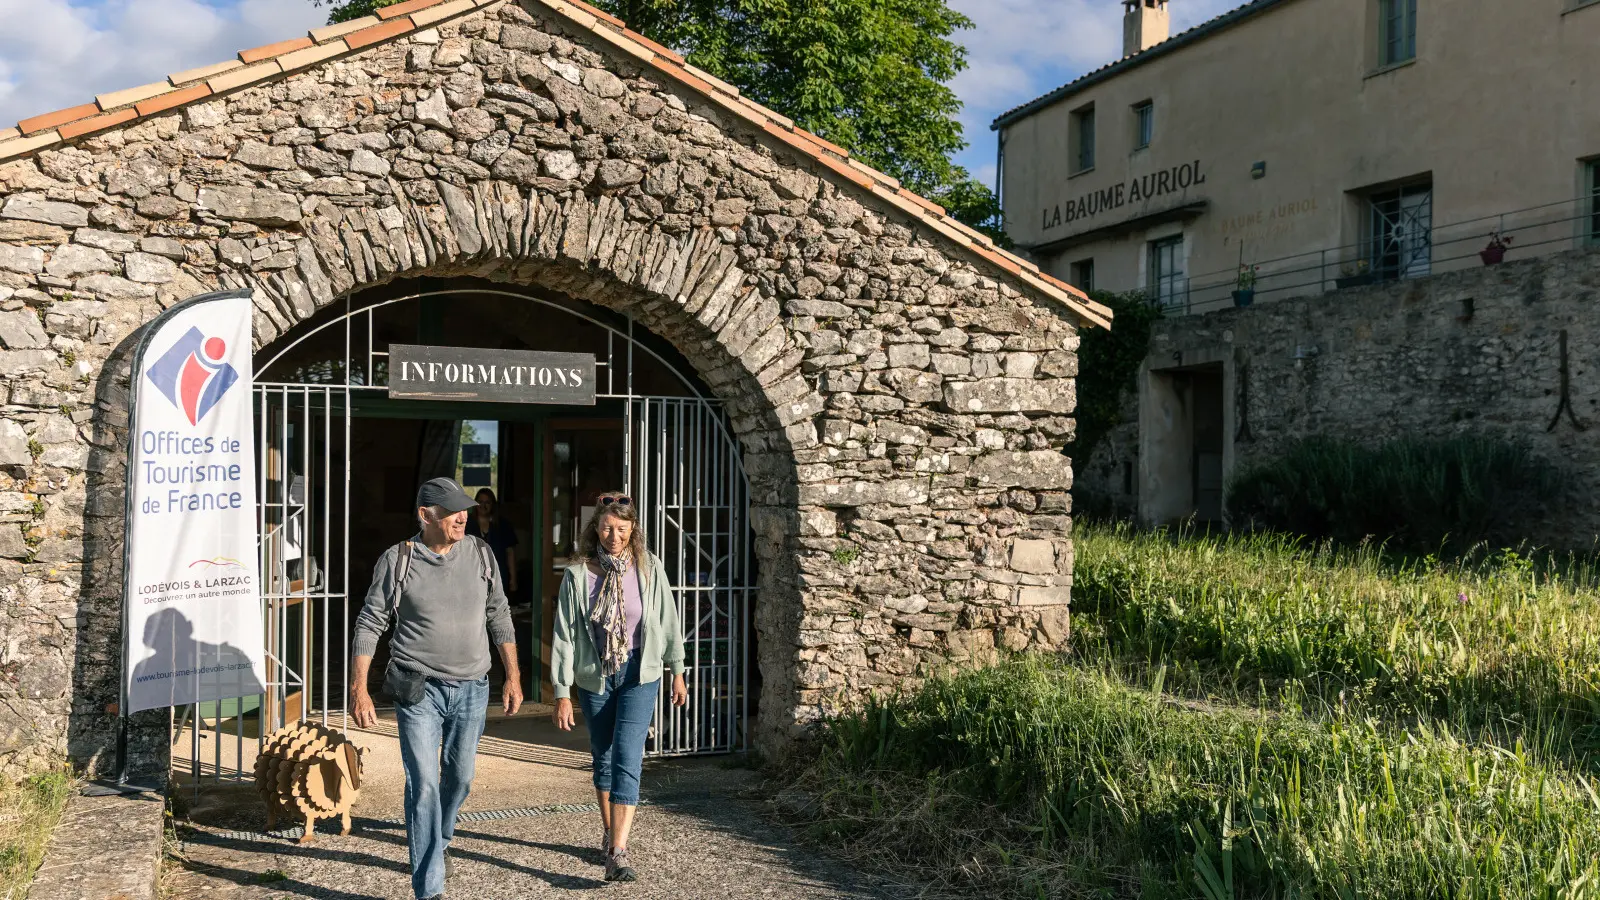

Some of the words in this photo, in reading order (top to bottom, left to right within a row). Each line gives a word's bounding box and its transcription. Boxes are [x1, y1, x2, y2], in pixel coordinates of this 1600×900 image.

[1042, 205, 1062, 231] LA
[1065, 182, 1125, 223] BAUME
[1128, 159, 1206, 204] AURIOL
[1221, 210, 1263, 233] BAUME
[1268, 197, 1318, 221] AURIOL
[401, 361, 583, 388] INFORMATIONS
[142, 430, 214, 455] Offices
[221, 436, 240, 453] de
[142, 460, 241, 484] Tourisme
[142, 497, 160, 515] de
[168, 489, 242, 513] France
[138, 581, 190, 595] LODÉVOIS
[194, 580, 202, 588] &
[205, 575, 251, 588] LARZAC
[185, 592, 196, 600] un
[198, 590, 221, 599] autre
[222, 587, 251, 596] monde
